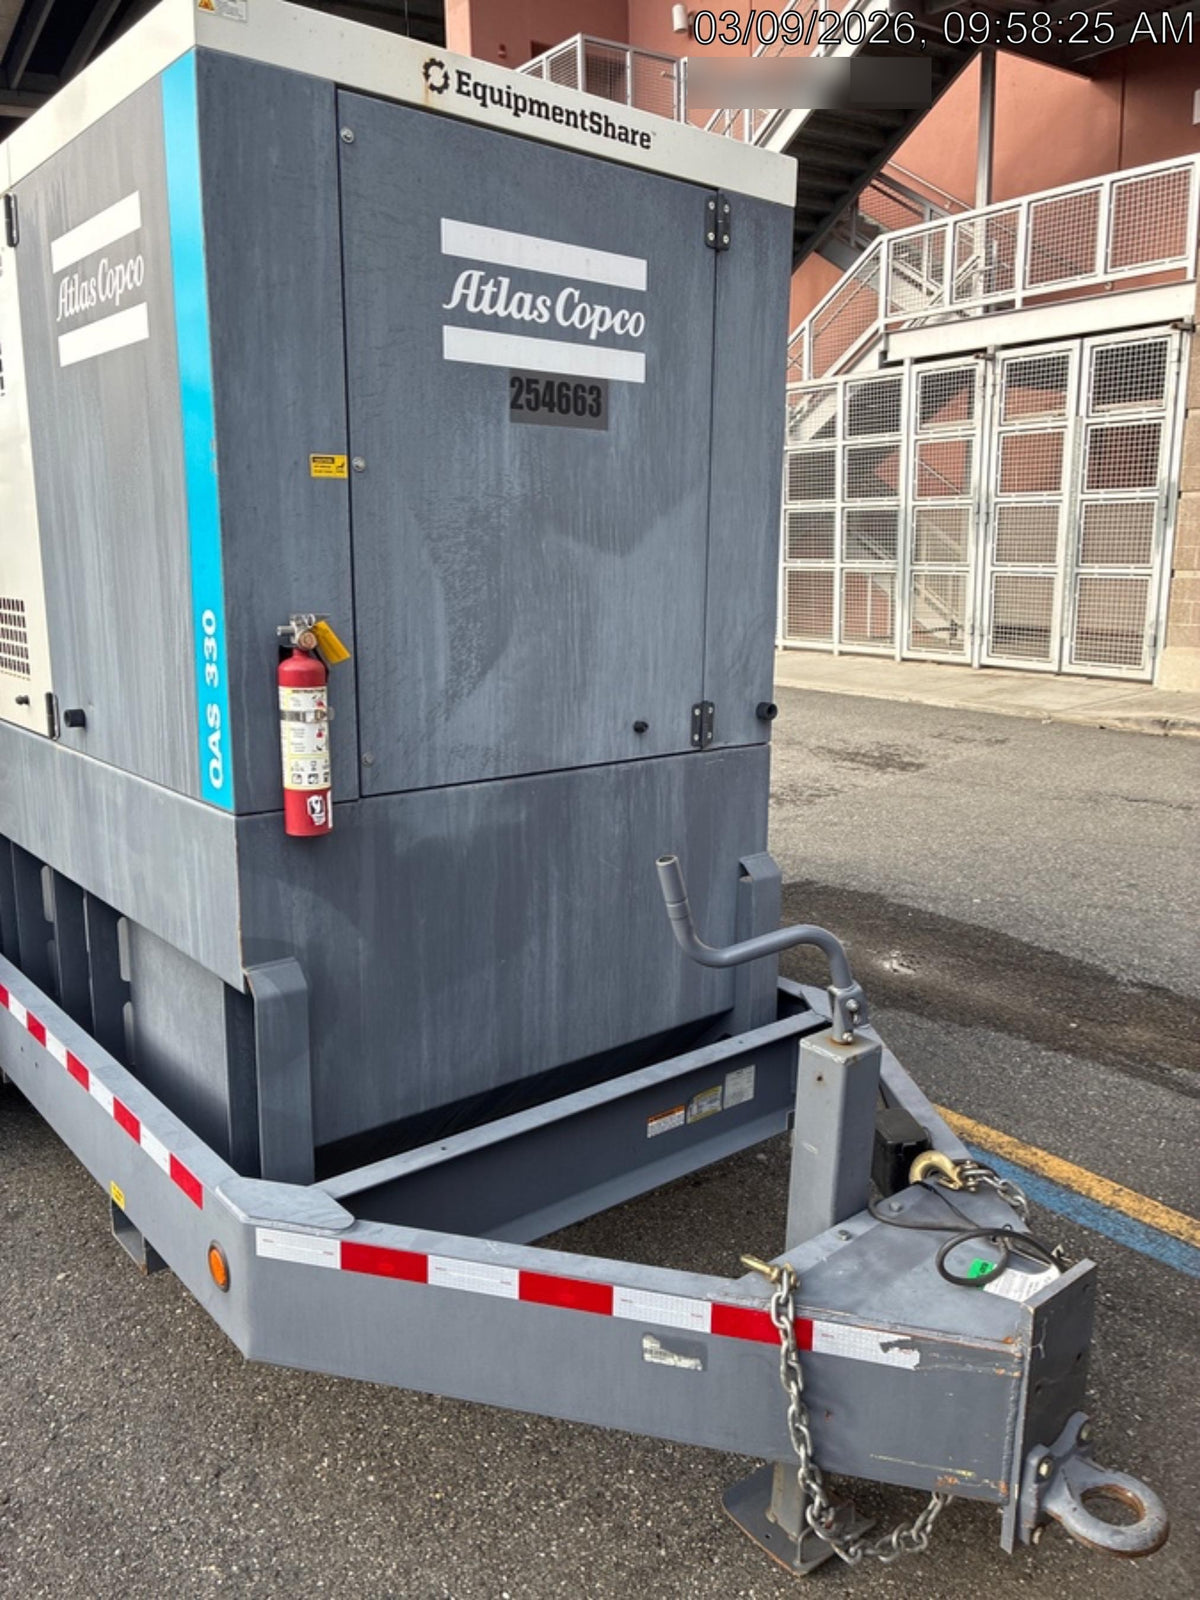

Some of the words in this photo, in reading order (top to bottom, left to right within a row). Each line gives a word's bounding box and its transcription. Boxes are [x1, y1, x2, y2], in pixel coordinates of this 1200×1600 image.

[455, 69, 651, 150] EquipmentShare
[56, 273, 97, 322] Atlas
[98, 254, 145, 306] Copco
[442, 269, 551, 324] Atlas
[555, 287, 646, 340] Copco
[509, 376, 601, 418] 254663
[202, 609, 219, 688] 330
[206, 703, 223, 790] QAS
